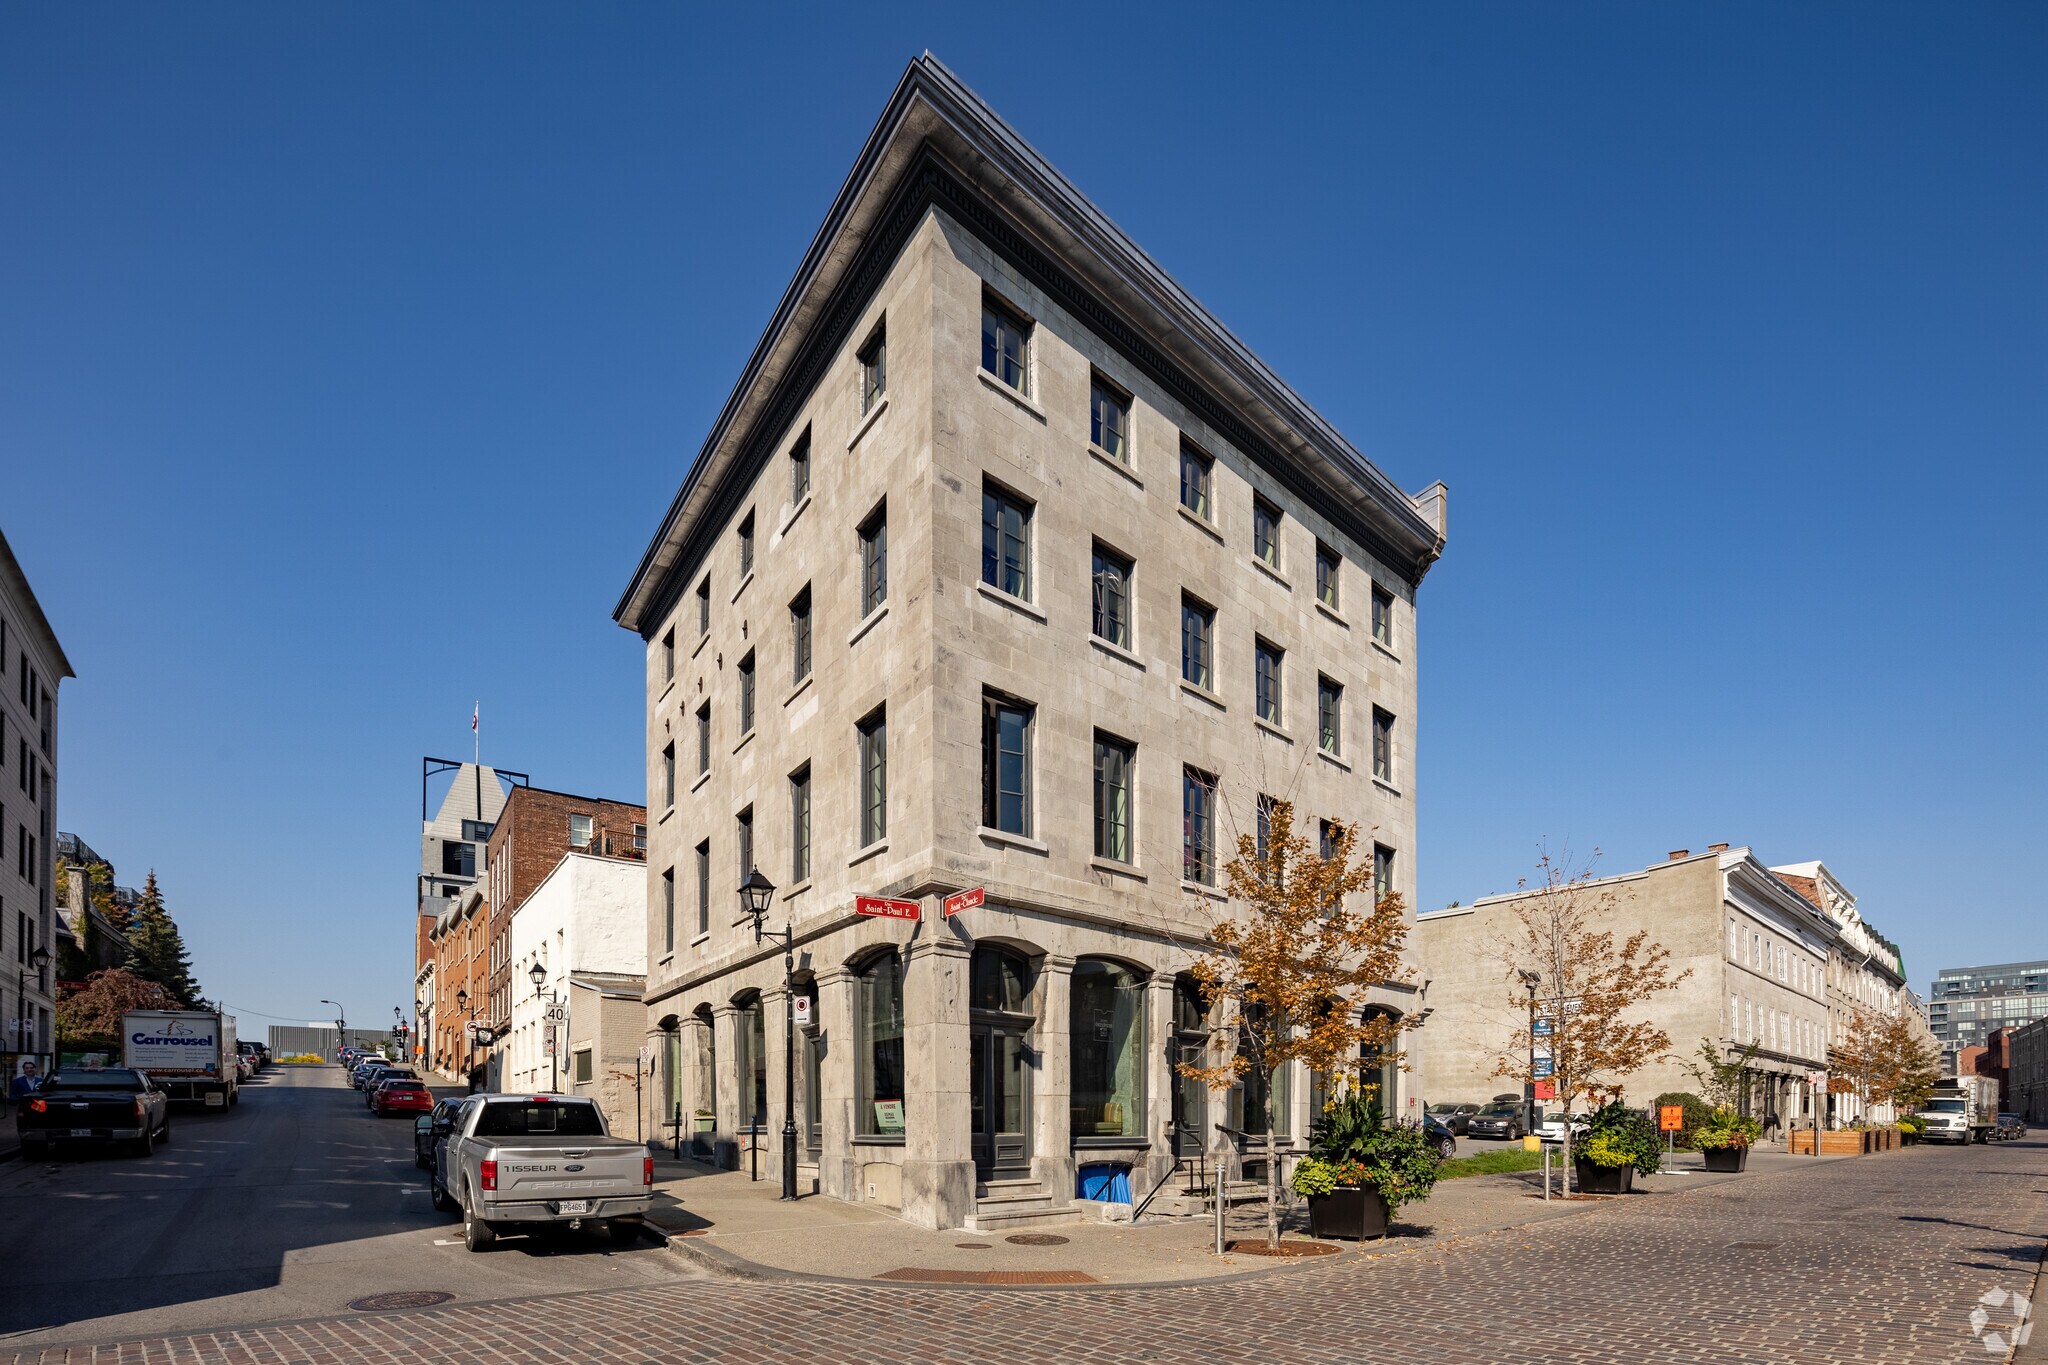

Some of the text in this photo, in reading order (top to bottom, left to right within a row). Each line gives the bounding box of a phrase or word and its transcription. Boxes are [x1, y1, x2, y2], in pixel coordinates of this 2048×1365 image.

[865, 903, 902, 916] Saint-Paul
[949, 895, 979, 912] Saint-Claude
[548, 1008, 563, 1020] 40
[131, 1032, 213, 1046] Carrousel
